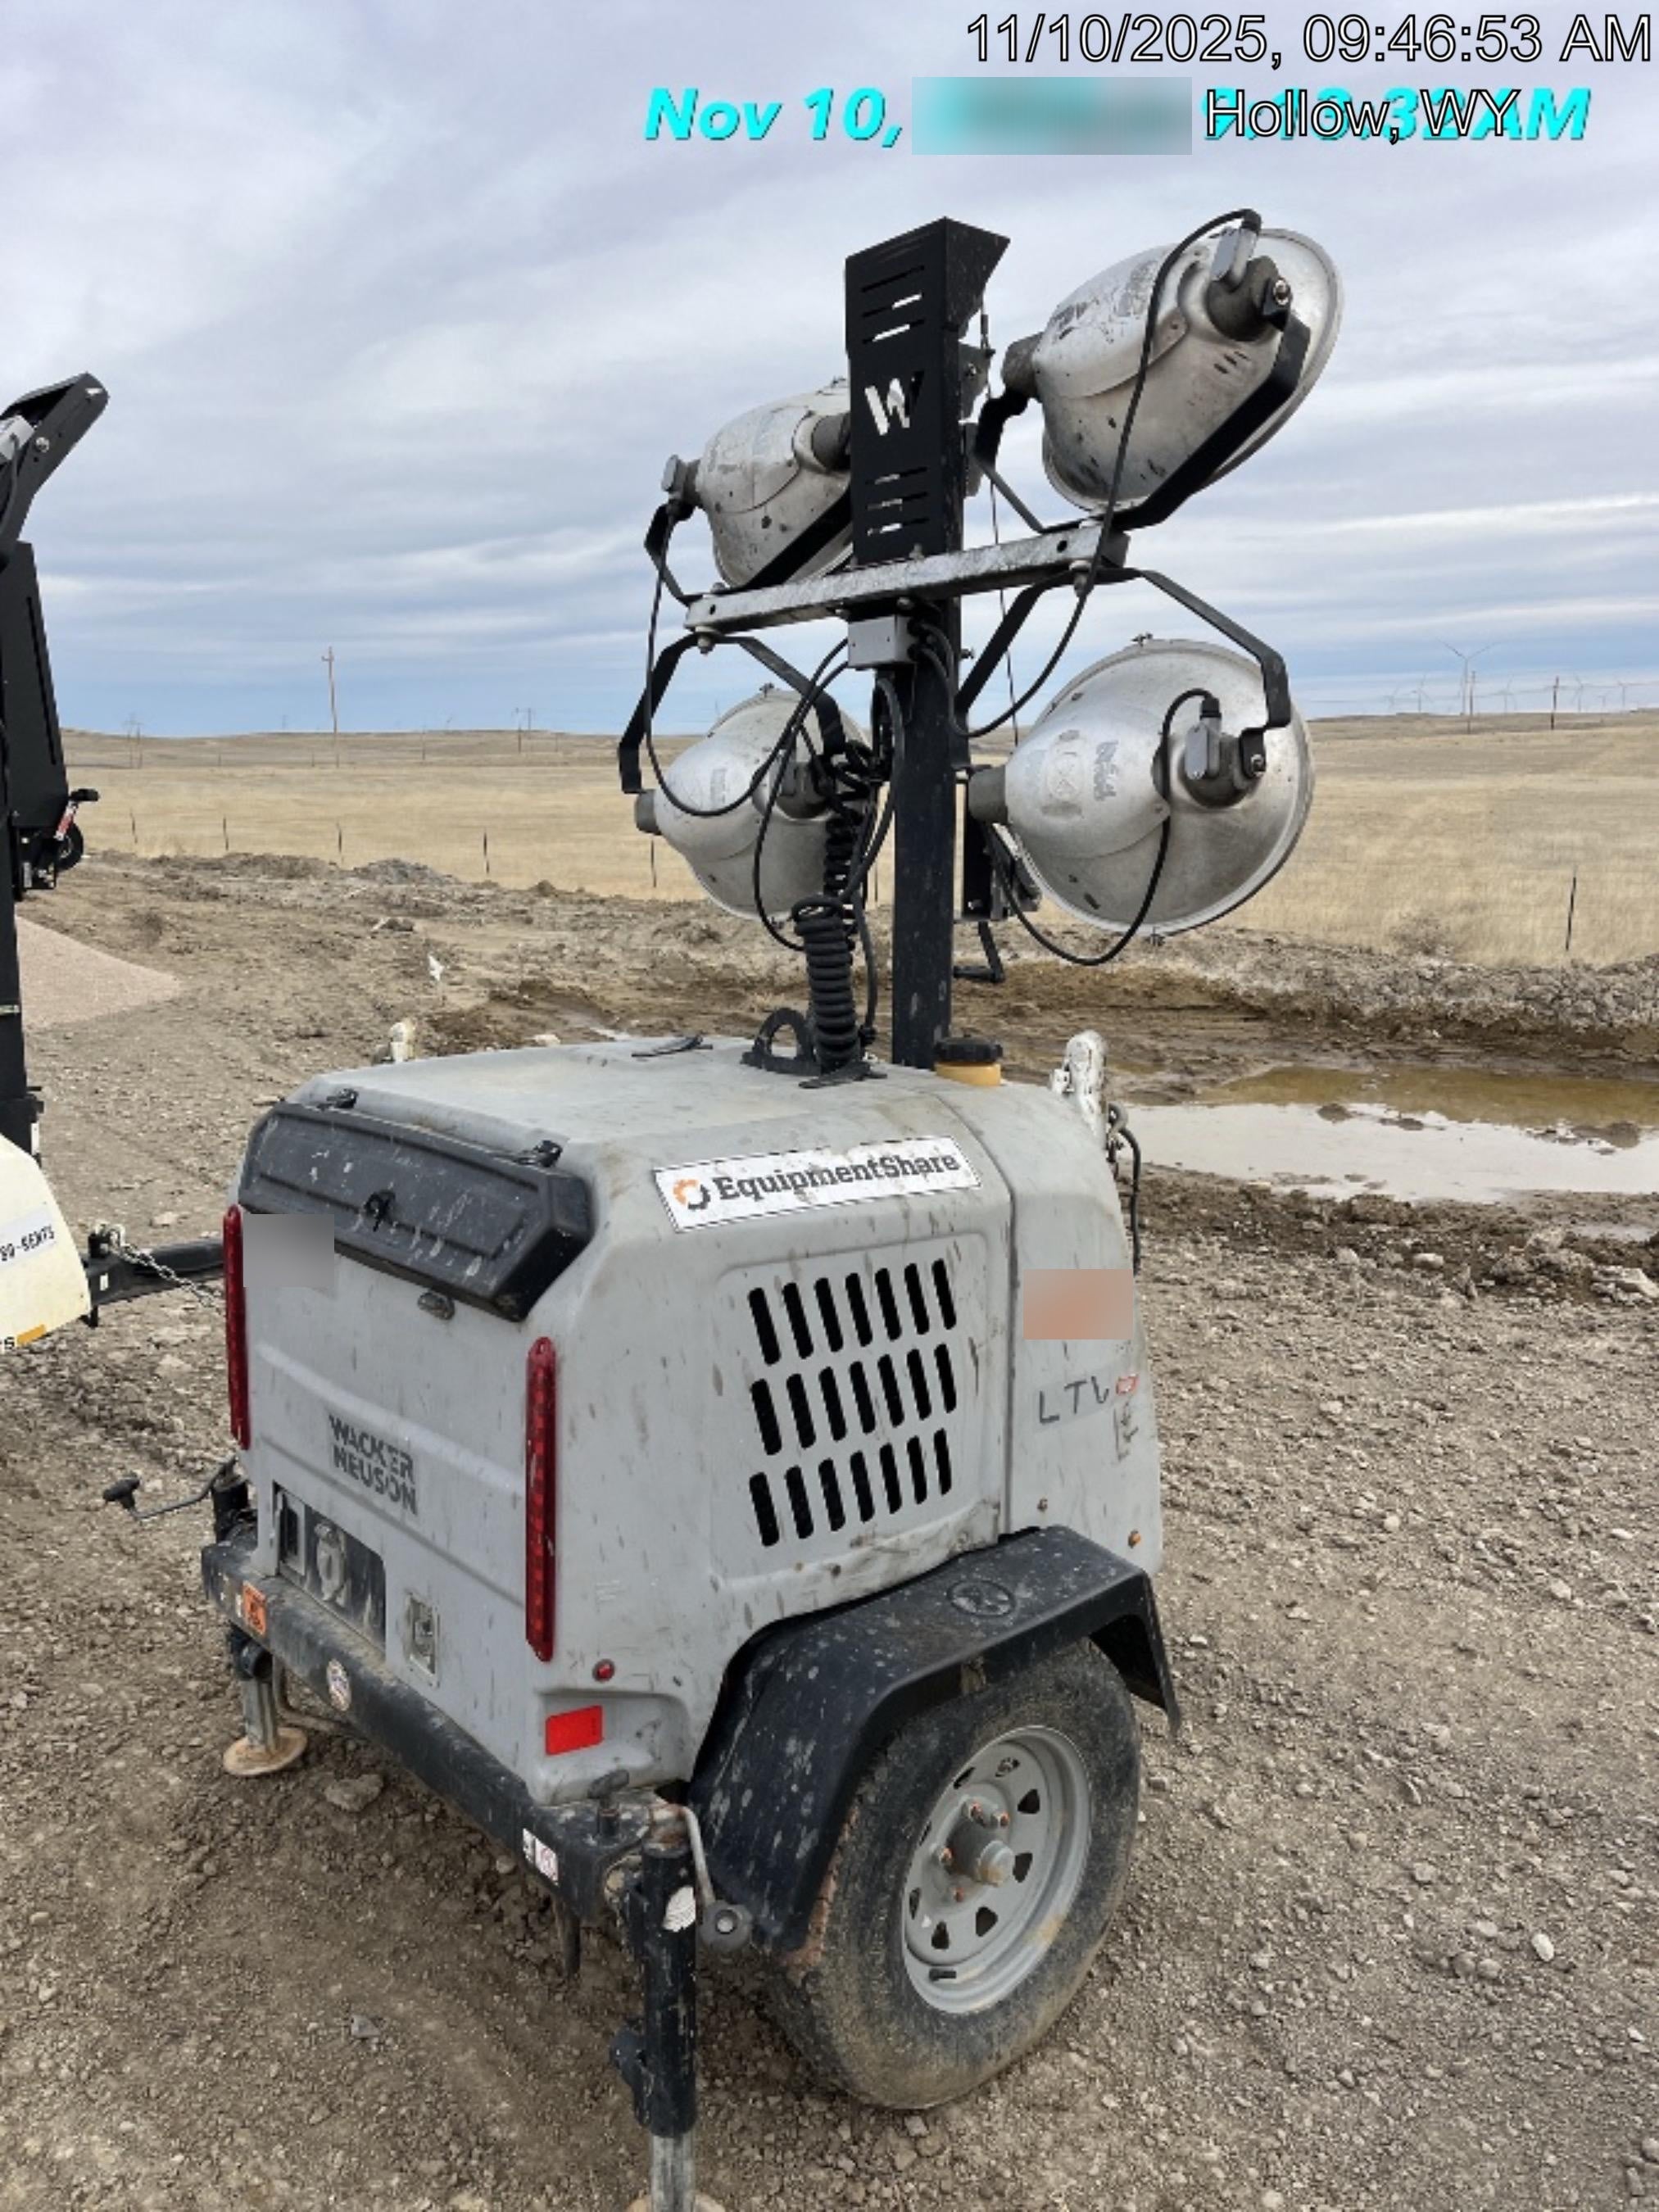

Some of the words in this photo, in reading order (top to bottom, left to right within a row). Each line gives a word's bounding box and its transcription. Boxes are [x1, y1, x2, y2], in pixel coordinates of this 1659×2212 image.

[712, 1153, 961, 1202] EquipmentShare
[329, 1415, 415, 1485] WACKER
[333, 1444, 418, 1516] NEUSON
